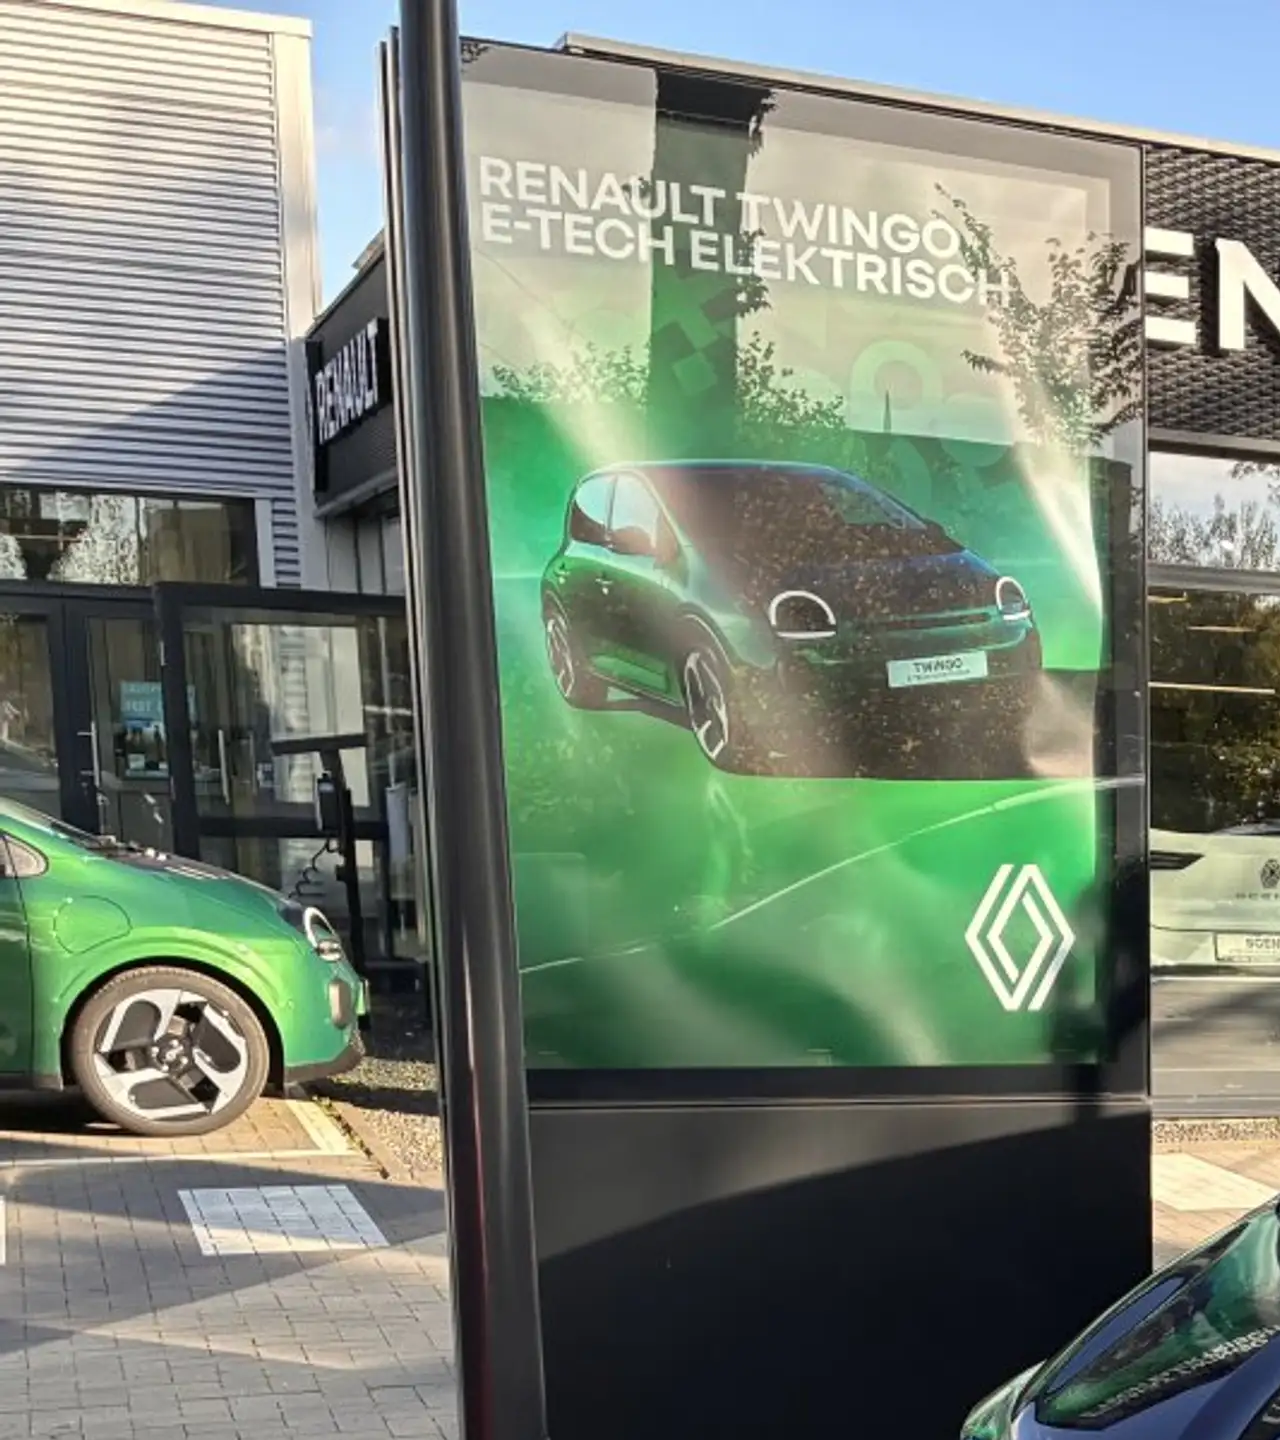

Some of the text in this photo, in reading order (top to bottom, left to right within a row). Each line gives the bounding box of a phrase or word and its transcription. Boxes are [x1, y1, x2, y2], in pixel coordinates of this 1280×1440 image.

[480, 156, 961, 259] RENAULT TWINGO
[482, 202, 1012, 306] E-TECH ELEKTRISCH
[315, 316, 378, 445] RENAULT
